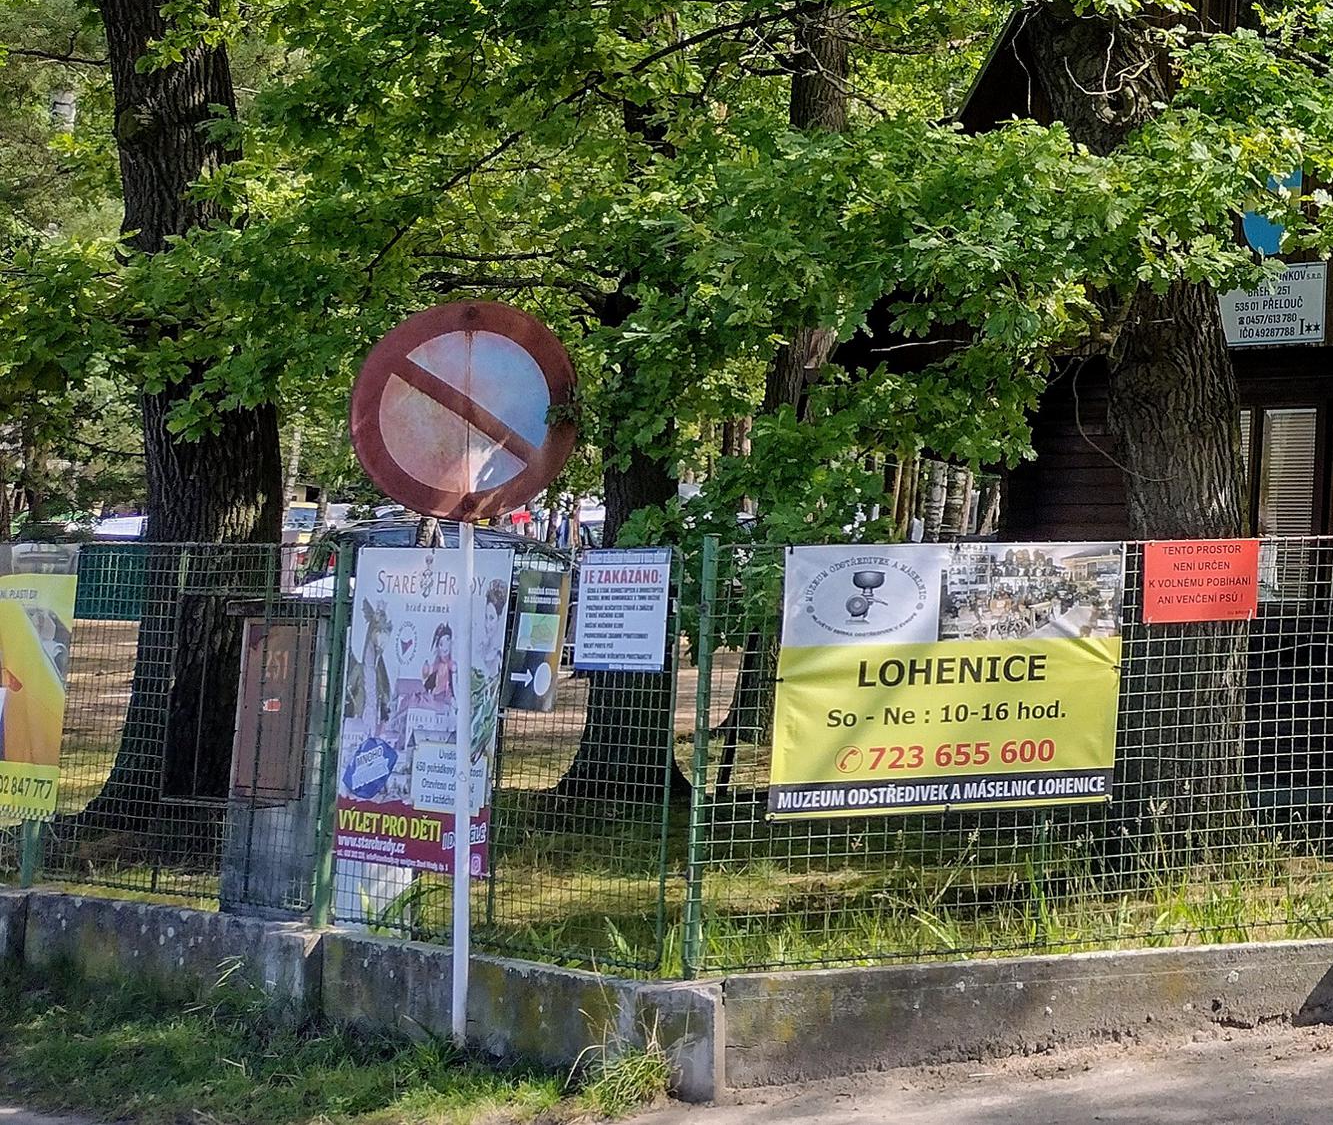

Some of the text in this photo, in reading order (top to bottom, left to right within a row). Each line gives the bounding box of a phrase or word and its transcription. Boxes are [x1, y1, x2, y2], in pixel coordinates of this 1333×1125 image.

[1277, 285, 1291, 295] 251
[1262, 296, 1304, 310] PŘELOUČ
[1245, 313, 1298, 325] 0457/613 780
[1239, 327, 1254, 338] IČO
[1162, 545, 1242, 555] TENTO PROSTOR
[1173, 561, 1230, 571] NENÍ URČEN
[436, 571, 486, 596] HRY
[583, 566, 663, 585] JE ZAKÁZÁNO:
[805, 556, 928, 602] MUZEUM ODSTŘEDIVEK A MÁSELNIC
[1149, 579, 1155, 588] K
[1157, 577, 1204, 588] VOLNÉMU
[1157, 596, 1174, 604] ANI
[1176, 593, 1217, 604] VENČENÍ
[1219, 591, 1239, 602] PSŮ
[405, 602, 420, 613] hrad
[857, 654, 1048, 689] LOHENICE
[826, 708, 857, 728] So
[883, 707, 916, 726] Ne
[939, 702, 1010, 724] 10-16
[1016, 699, 1067, 720] hod.
[868, 738, 1056, 771] 723 655 600
[11, 776, 31, 797] 847
[33, 778, 53, 800] 777
[777, 774, 1106, 810] MUZEUM ODSTŘEDIVEK A MÁSELNIC LOHENICE
[338, 806, 381, 835] VÝLET
[381, 813, 408, 838] PRO
[410, 815, 442, 843] DĚTI
